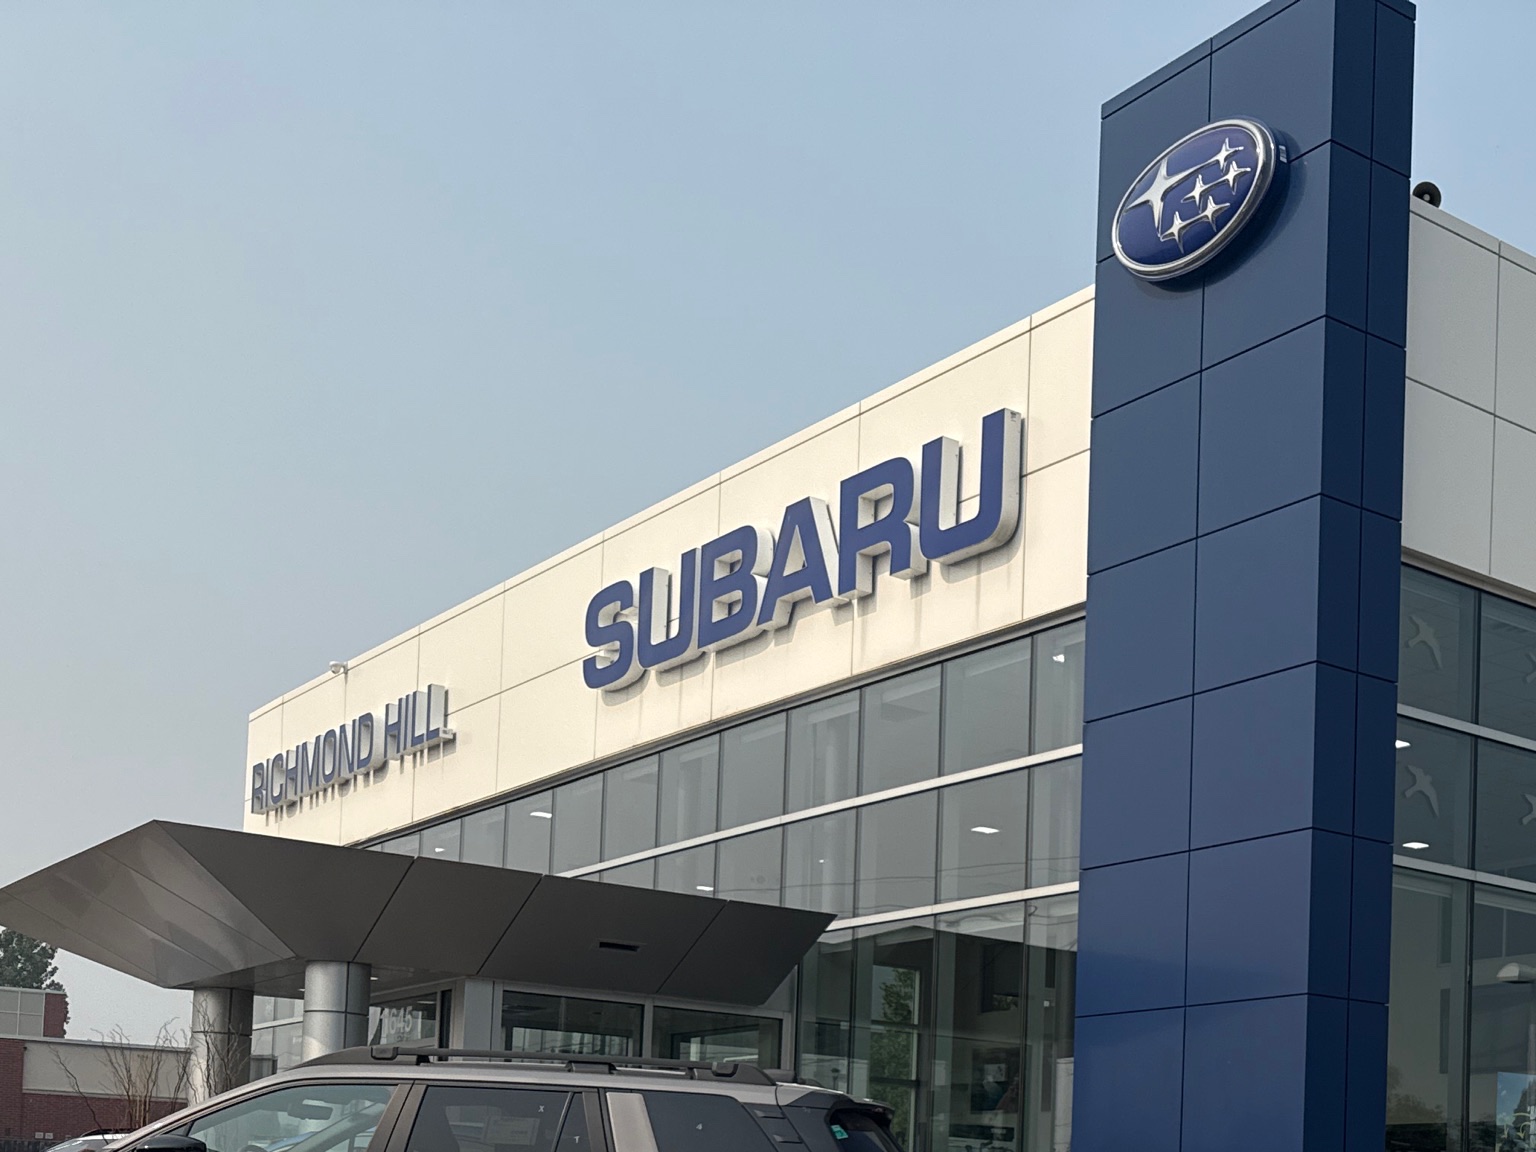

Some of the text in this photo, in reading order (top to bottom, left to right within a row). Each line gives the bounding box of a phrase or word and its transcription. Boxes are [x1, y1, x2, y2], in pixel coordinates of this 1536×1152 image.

[583, 408, 1012, 690] SUBARU
[251, 684, 446, 814] RICHMOND HILL
[380, 1006, 413, 1036] 1645
